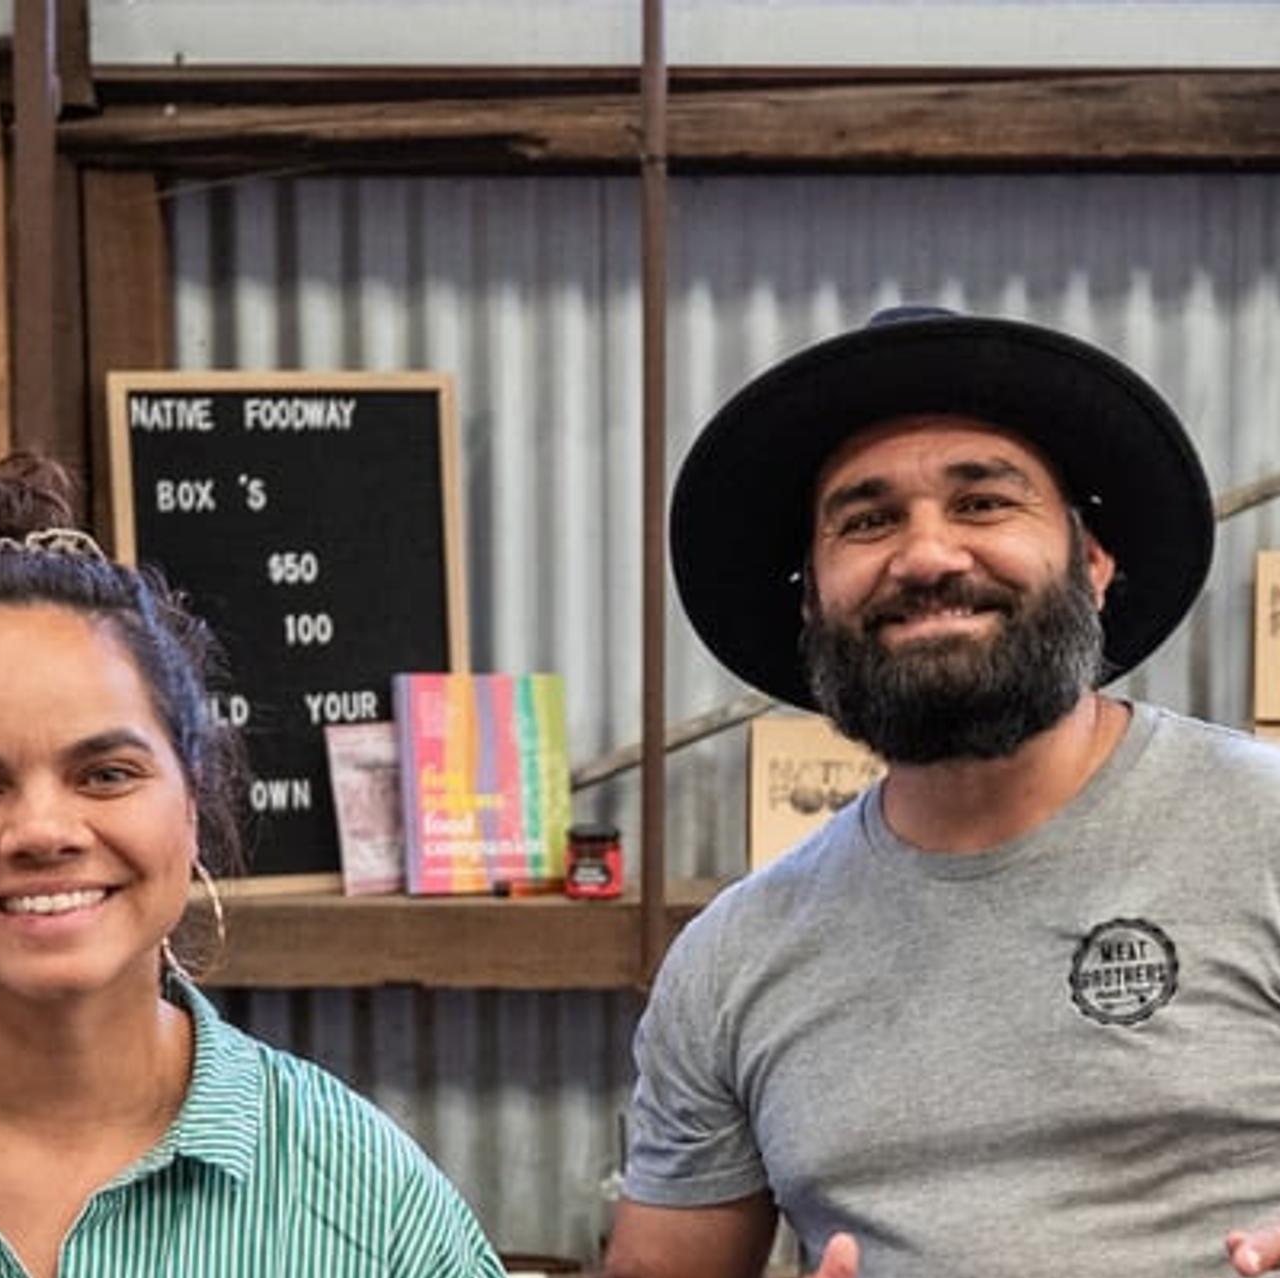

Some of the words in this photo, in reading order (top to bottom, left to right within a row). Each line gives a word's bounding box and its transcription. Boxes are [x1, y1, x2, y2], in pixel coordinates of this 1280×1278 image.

[130, 397, 215, 431] NATIVE
[243, 398, 356, 431] FOODWAY
[156, 480, 216, 512] BOX
[269, 552, 318, 583] $50
[284, 614, 334, 644] 100
[305, 691, 378, 724] YOUR
[251, 779, 311, 811] OWN
